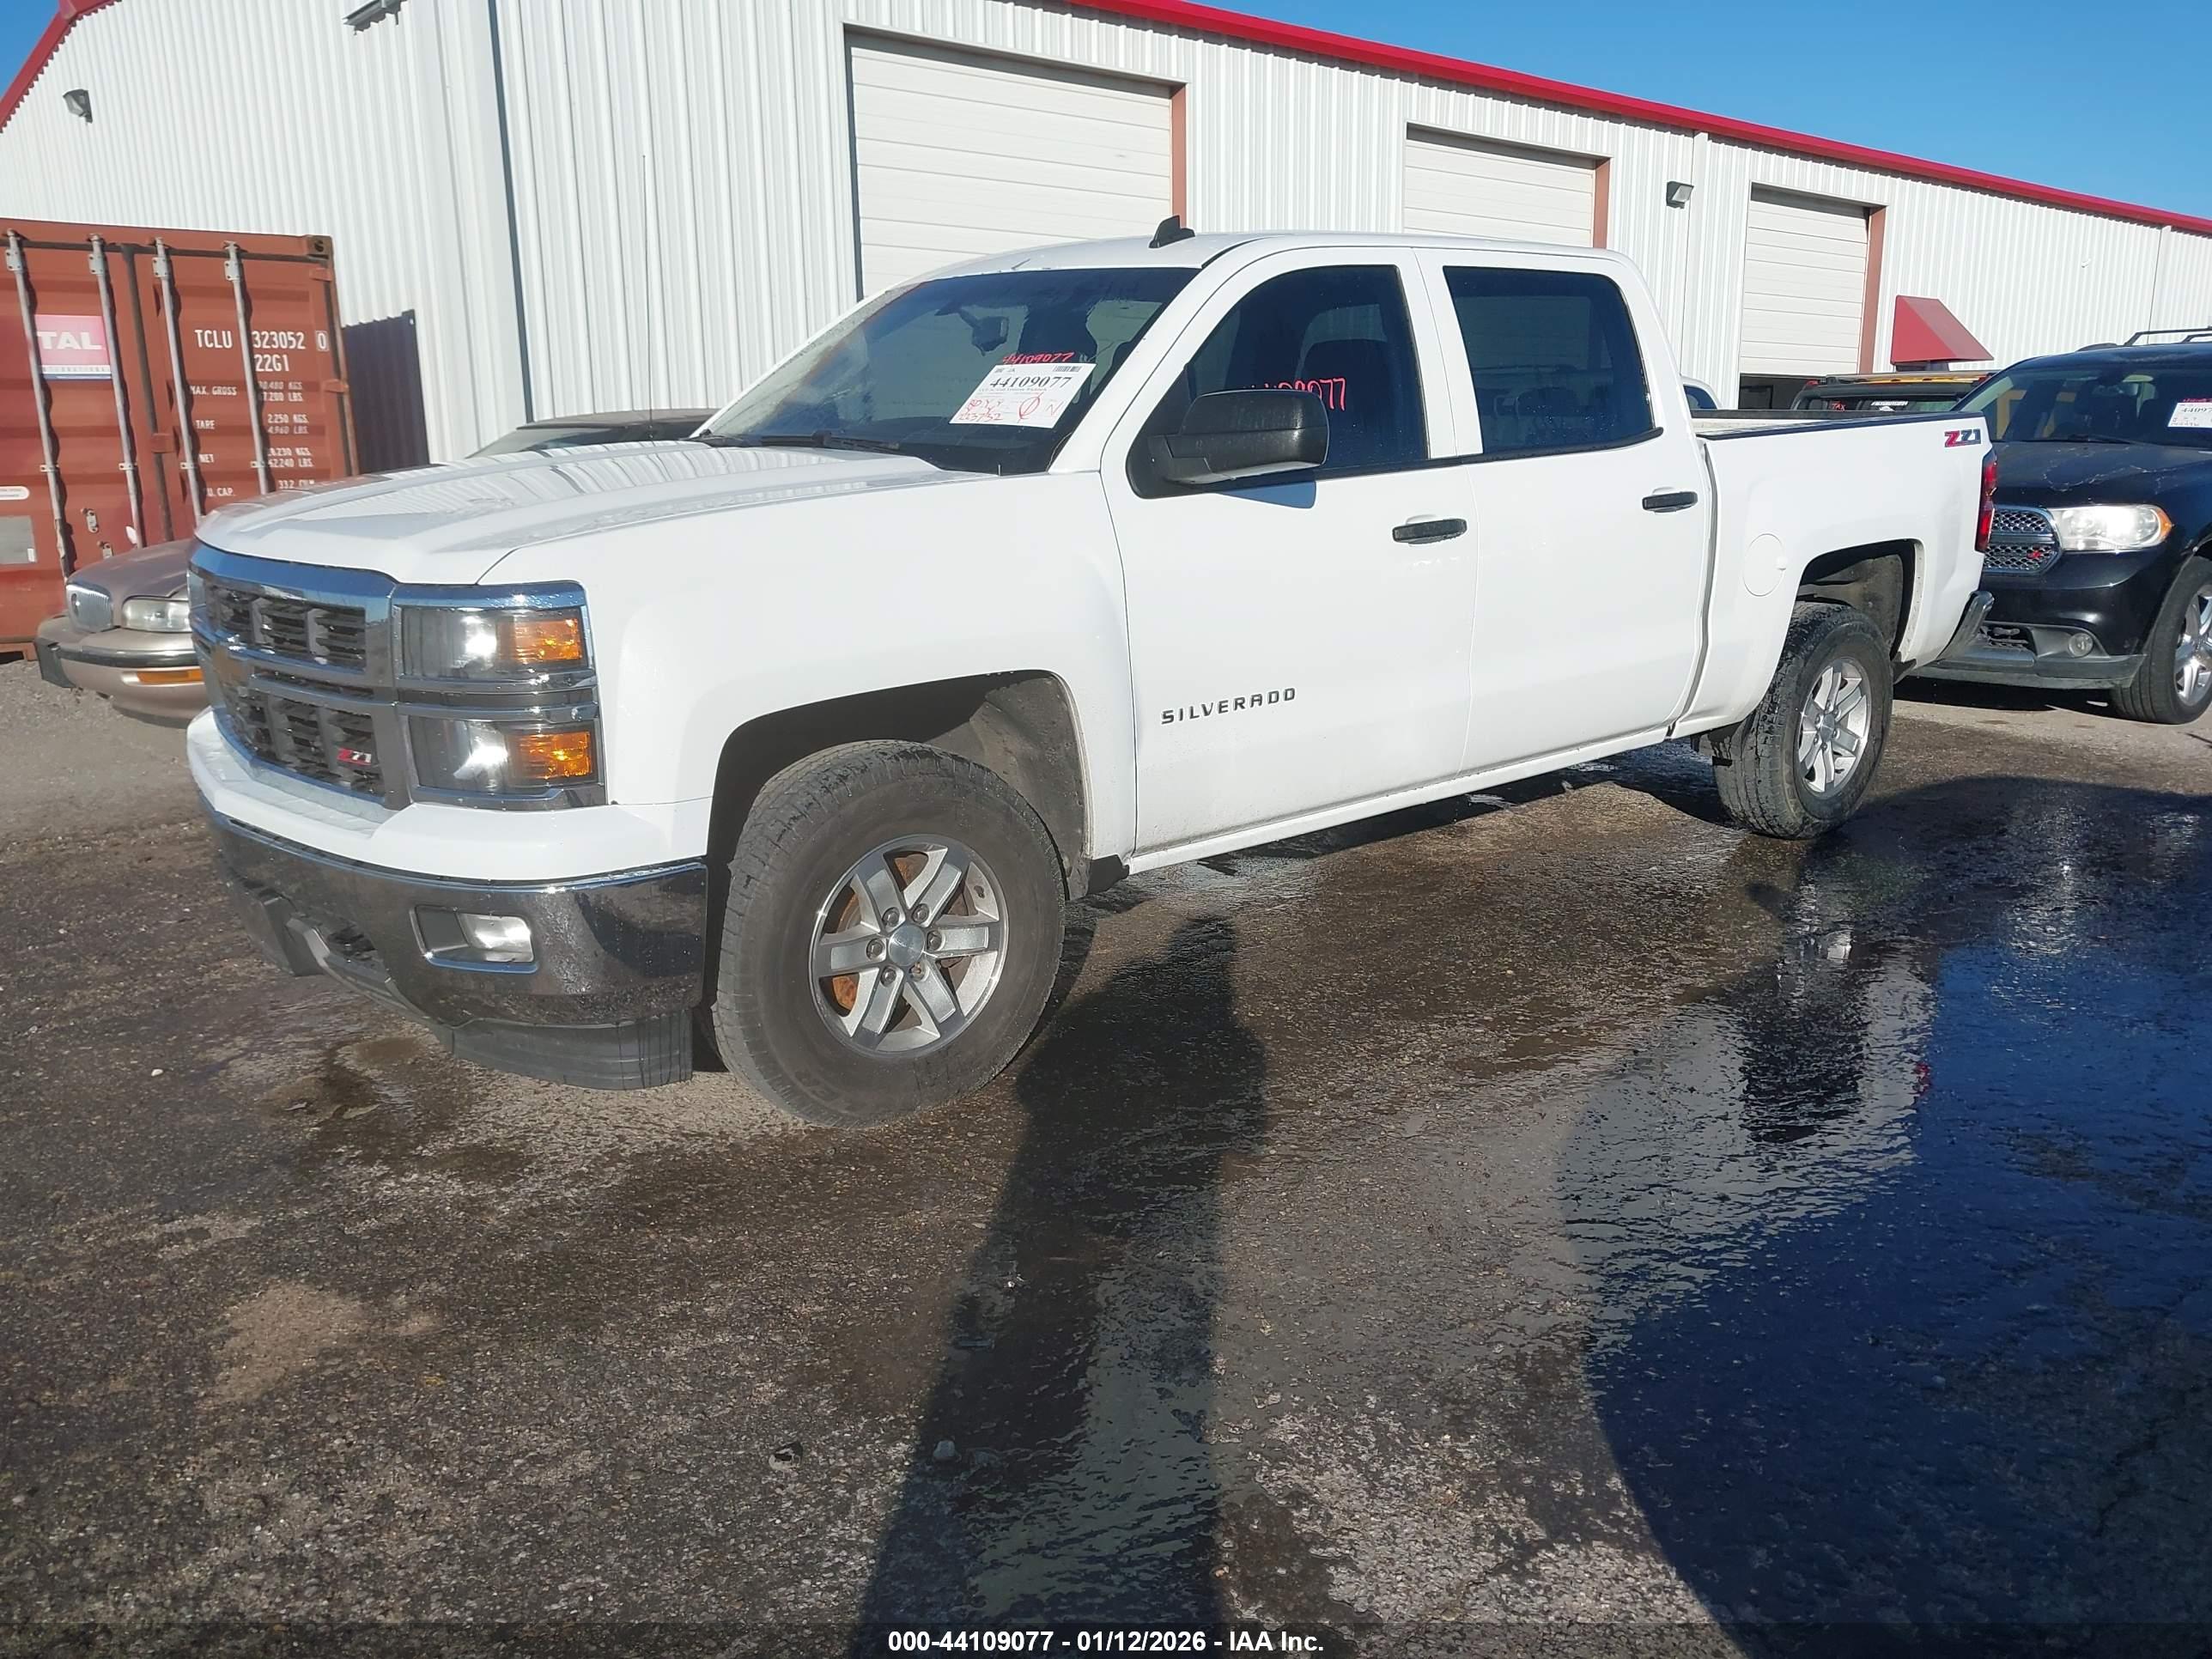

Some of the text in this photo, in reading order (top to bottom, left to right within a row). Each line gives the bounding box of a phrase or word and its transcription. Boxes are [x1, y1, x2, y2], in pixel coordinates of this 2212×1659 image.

[37, 331, 102, 349] TAL
[195, 330, 233, 349] TCLU
[252, 331, 306, 349] 323052
[254, 354, 289, 372] 22G1
[990, 376, 1073, 388] 44109077
[212, 386, 237, 396] GROSS
[196, 420, 215, 429] TARE
[268, 414, 289, 423] 2.250
[1944, 428, 1981, 447] Z71
[198, 454, 215, 463] NET
[217, 488, 237, 498] CAP.
[1161, 687, 1296, 725] SILVERADO
[336, 748, 372, 766] Z71
